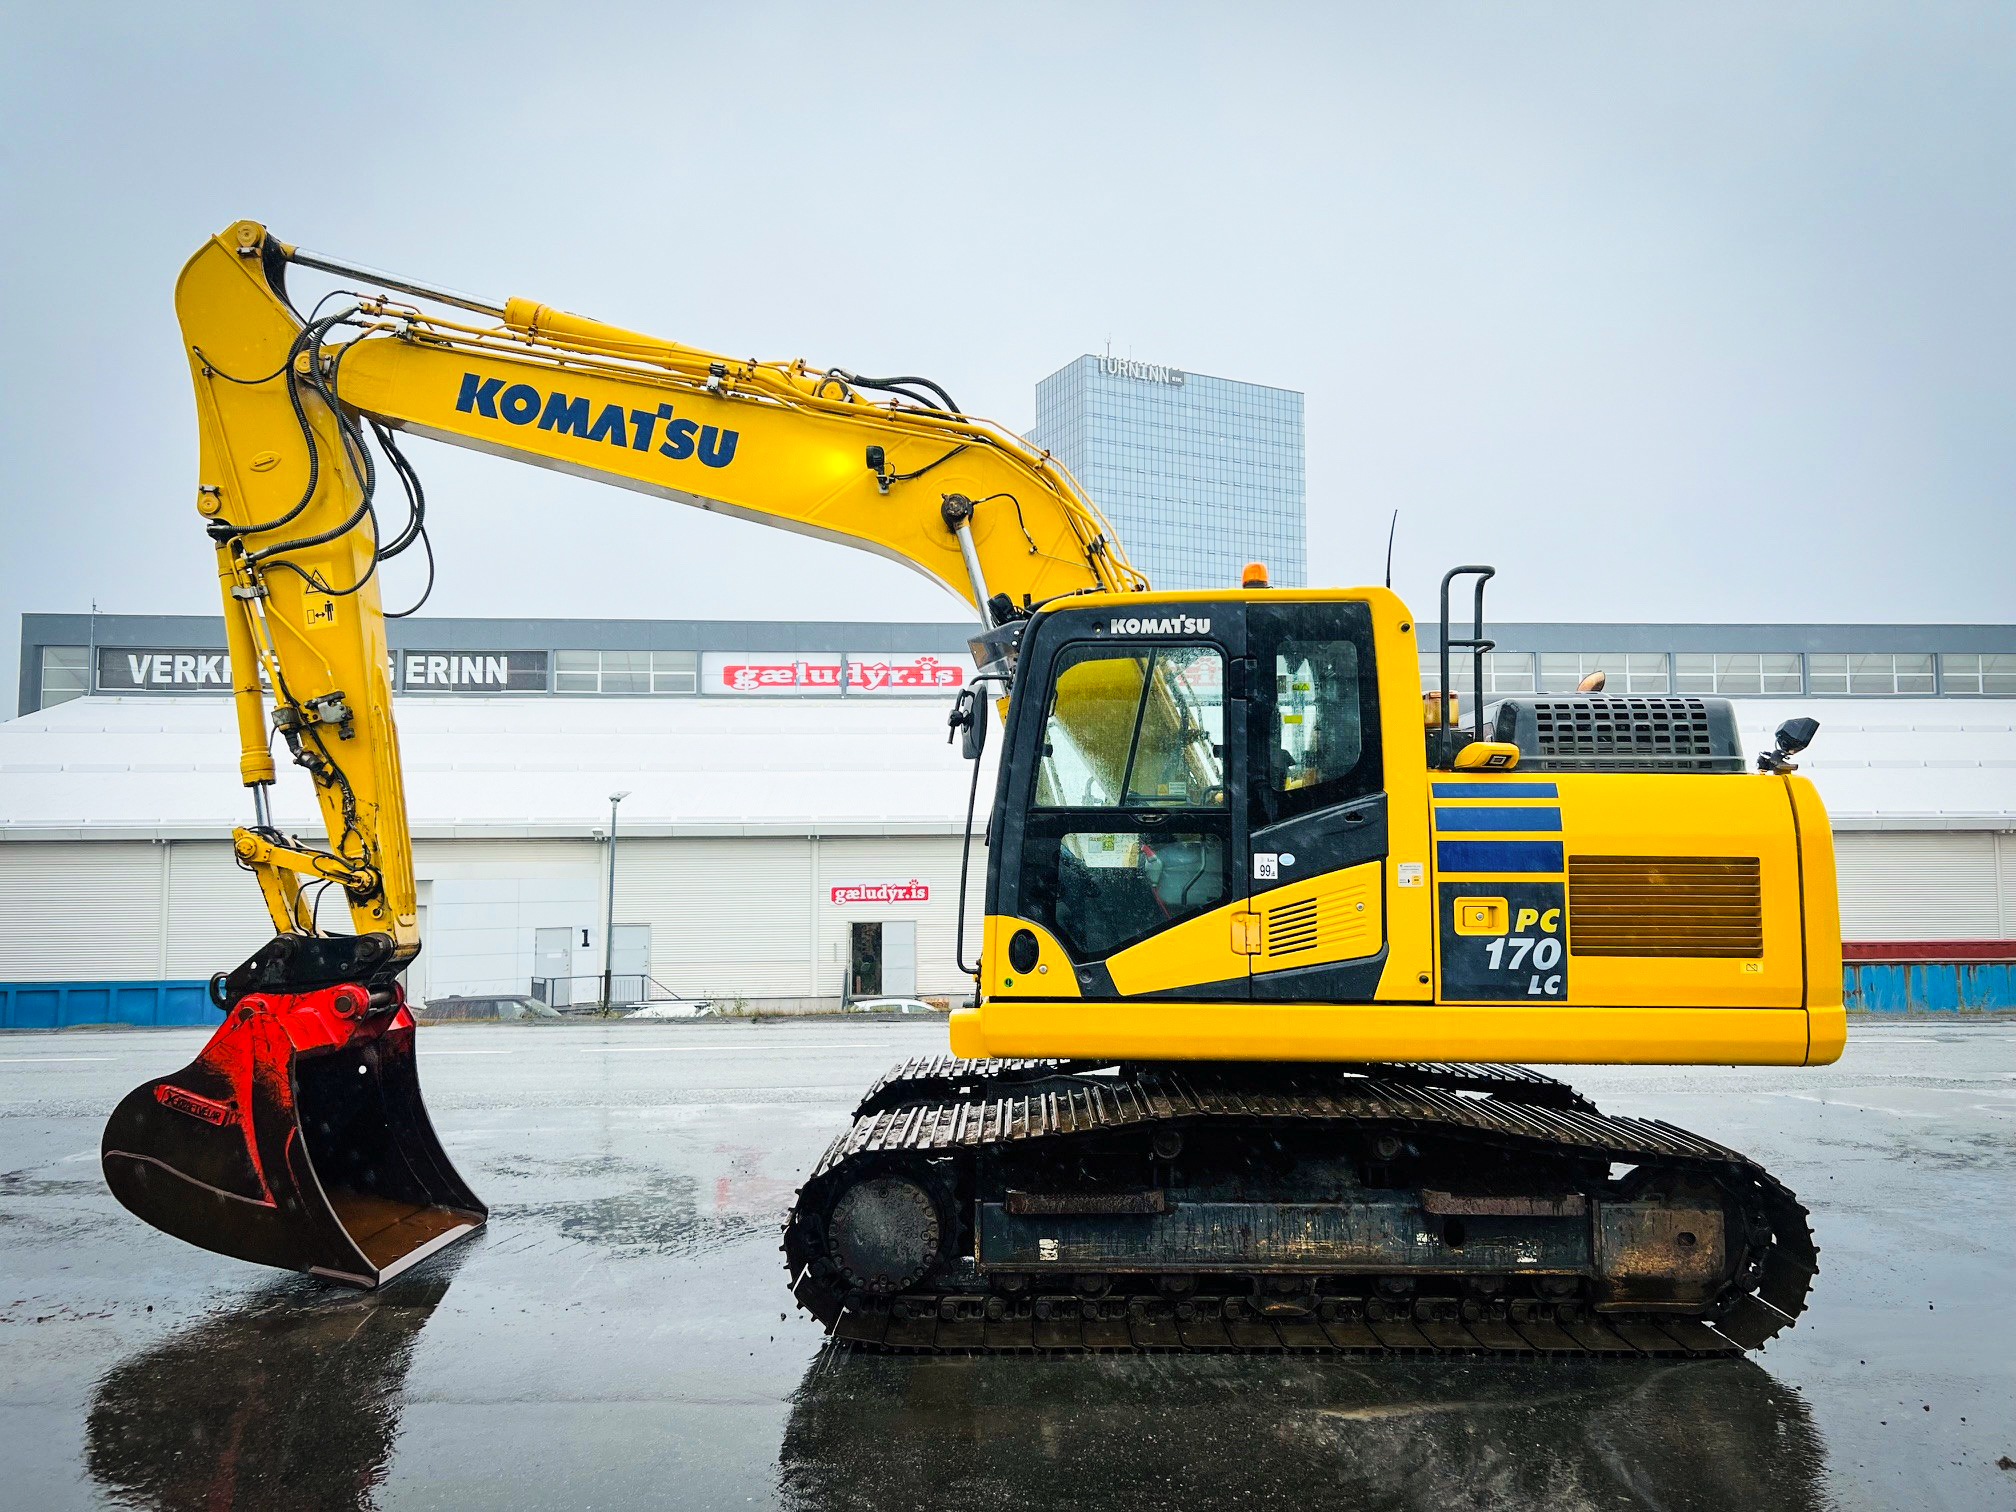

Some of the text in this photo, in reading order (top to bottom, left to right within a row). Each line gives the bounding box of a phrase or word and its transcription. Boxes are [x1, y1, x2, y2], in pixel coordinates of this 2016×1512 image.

[1096, 356, 1170, 384] TURNINN
[455, 372, 740, 469] KOMATSU
[1110, 614, 1211, 634] KOMATSU
[732, 661, 956, 691] gæludýr.is
[1259, 864, 1271, 877] 99
[834, 883, 927, 905] gæludýr.is
[1515, 908, 1561, 933] PC
[581, 929, 590, 947] 1
[1485, 937, 1562, 971] 170
[1527, 974, 1562, 995] LC
